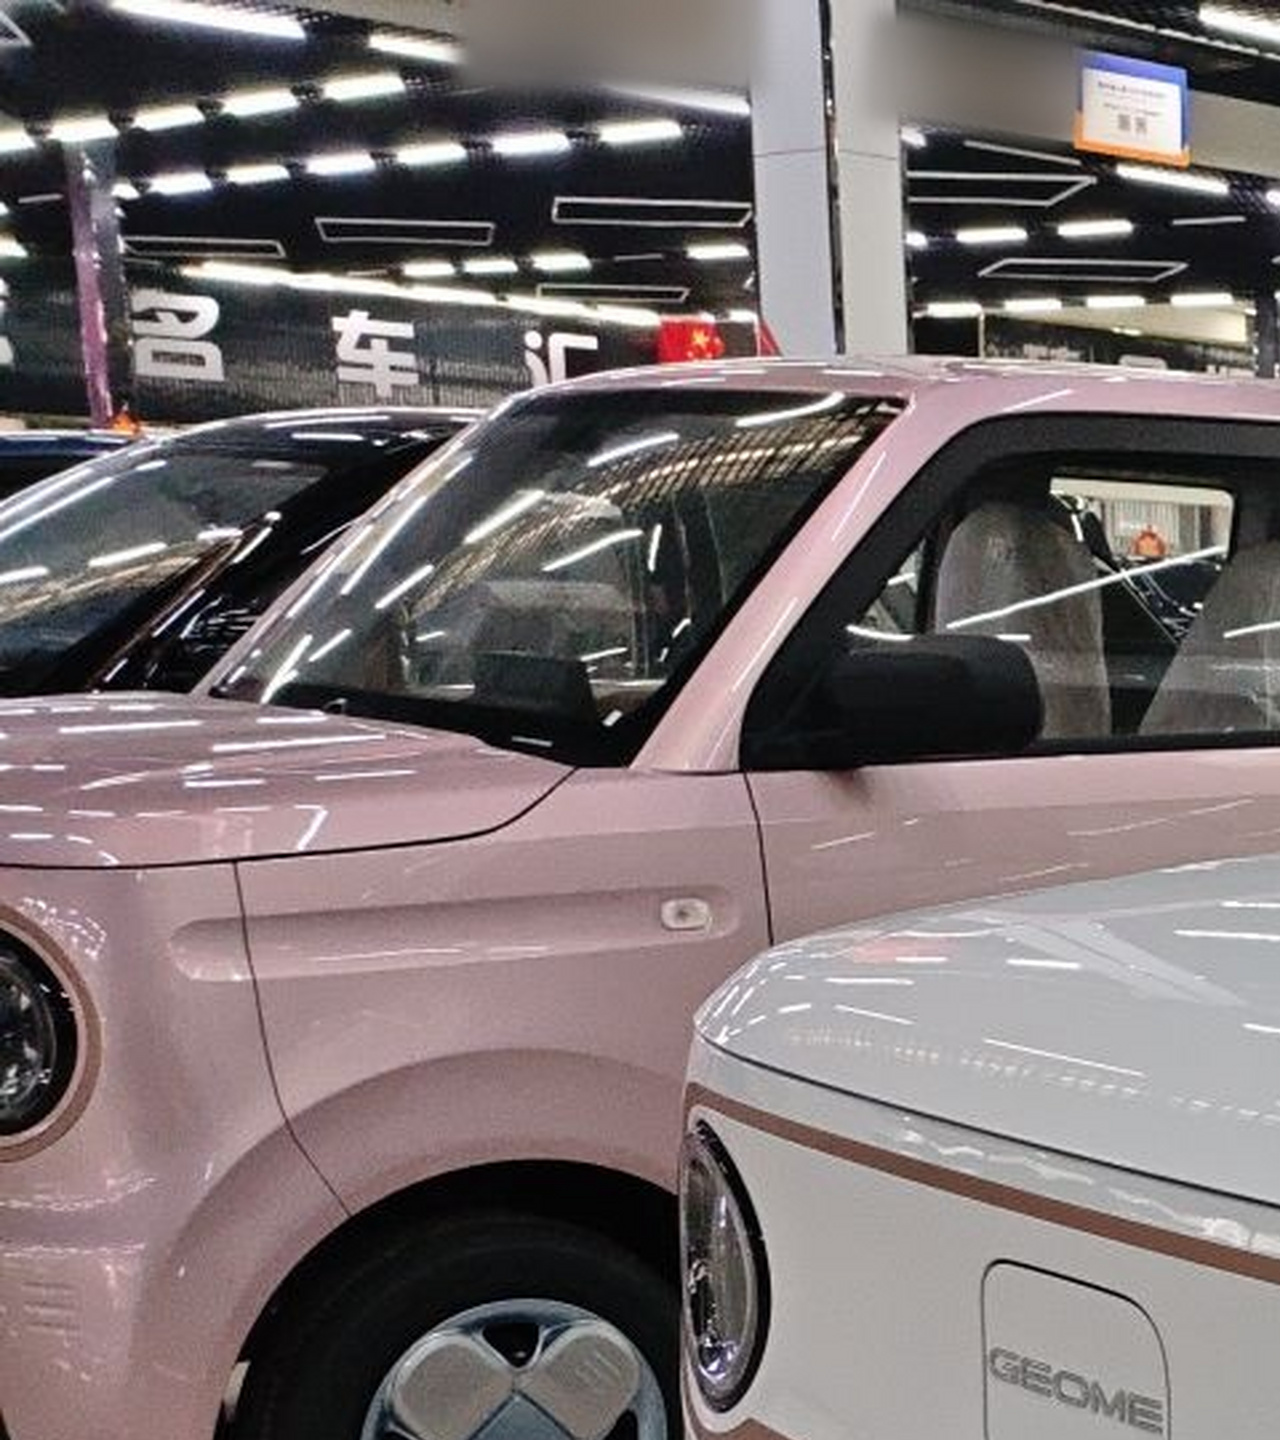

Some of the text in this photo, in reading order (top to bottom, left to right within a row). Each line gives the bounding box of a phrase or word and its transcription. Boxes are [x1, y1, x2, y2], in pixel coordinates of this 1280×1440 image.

[0, 289, 598, 399] 名车汇
[988, 1346, 1164, 1435] GEOME
